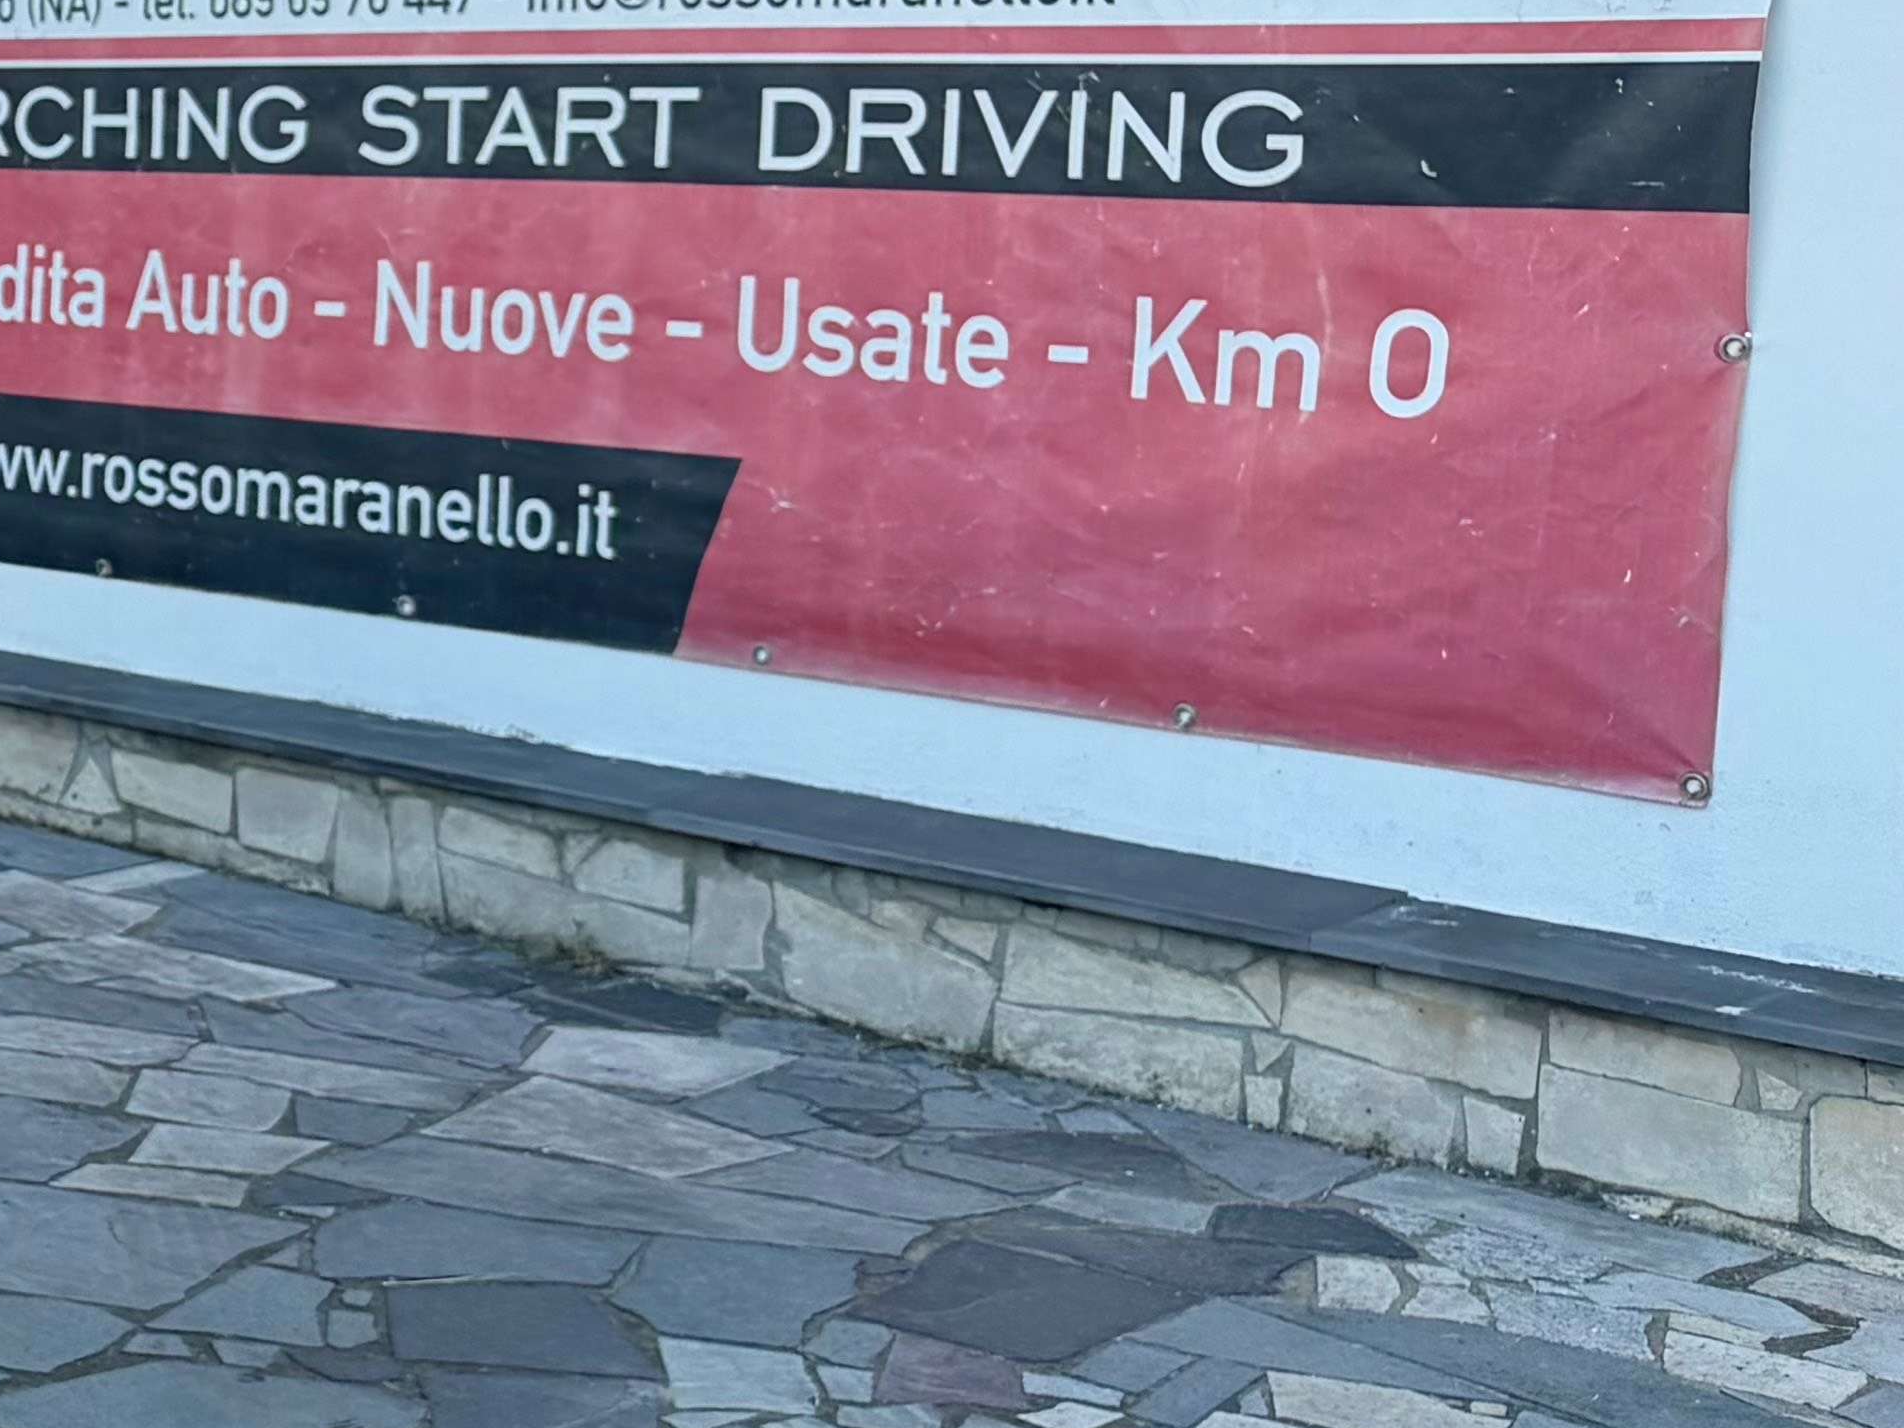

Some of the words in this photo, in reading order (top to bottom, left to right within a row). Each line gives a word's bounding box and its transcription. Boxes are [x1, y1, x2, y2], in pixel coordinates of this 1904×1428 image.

[358, 85, 701, 170] START
[758, 86, 1305, 189] DRIVING
[125, 249, 290, 340] Auto
[372, 258, 634, 363] Nuove
[738, 275, 1010, 389] Usate
[1130, 296, 1321, 413] Km
